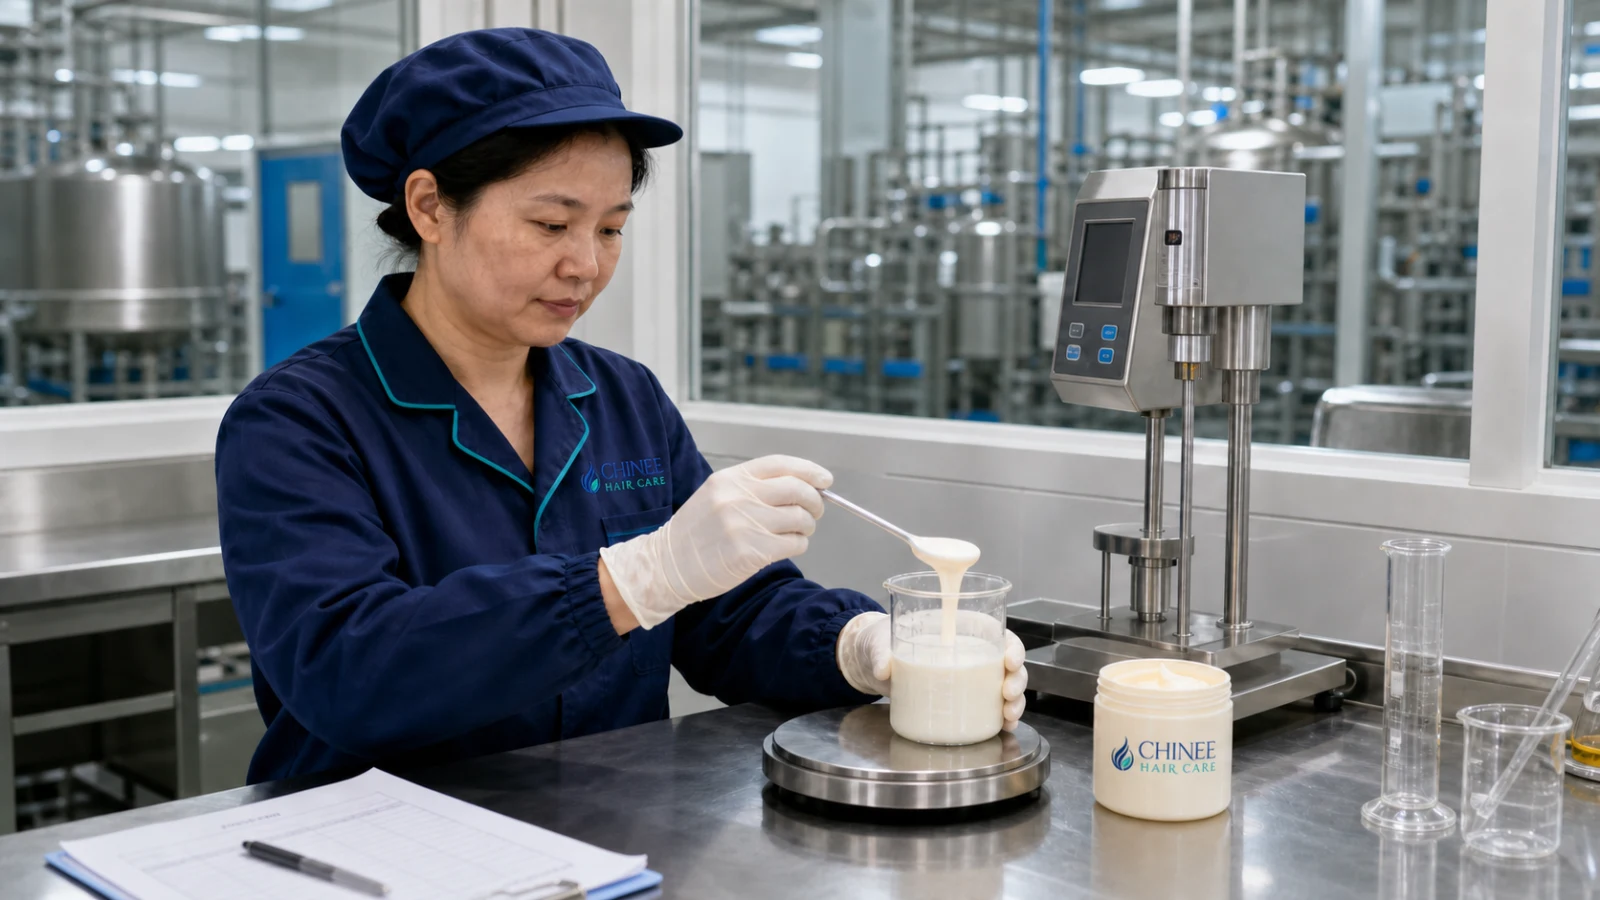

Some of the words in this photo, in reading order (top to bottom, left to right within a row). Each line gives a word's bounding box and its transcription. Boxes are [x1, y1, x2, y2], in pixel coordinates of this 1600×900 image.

[601, 458, 664, 479] CHINEE
[605, 480, 635, 492] HAIR
[636, 476, 666, 488] CARE
[1138, 740, 1216, 761] CHINEE
[1140, 762, 1178, 774] HAIR
[1182, 762, 1216, 773] CARE
